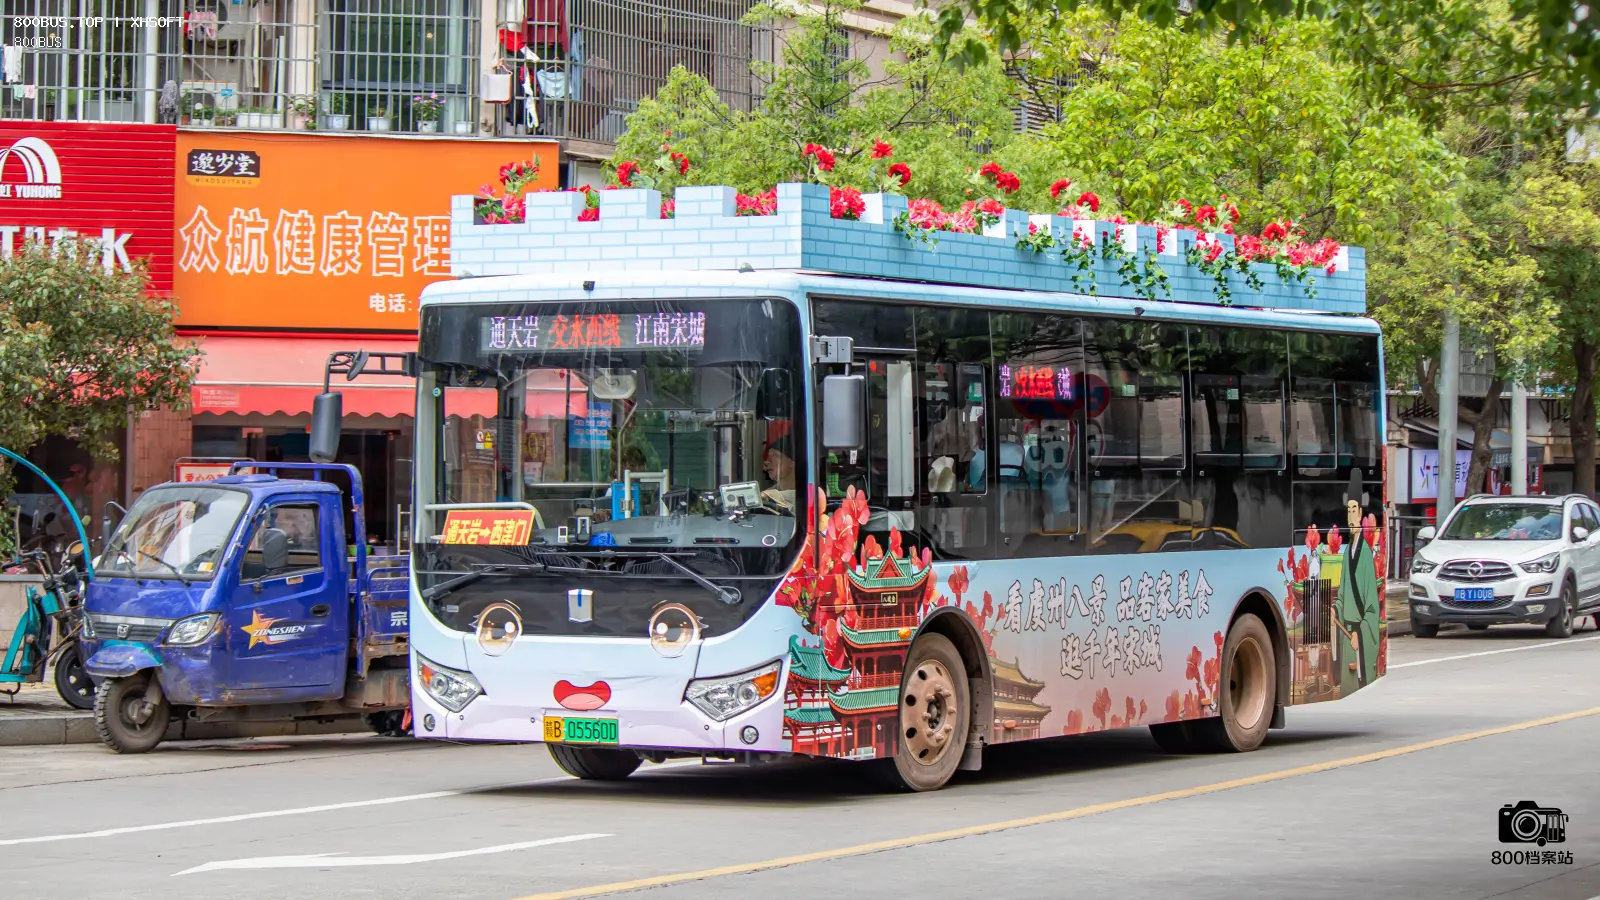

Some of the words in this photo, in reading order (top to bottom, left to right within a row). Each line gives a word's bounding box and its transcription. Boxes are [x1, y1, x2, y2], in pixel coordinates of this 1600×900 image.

[15, 185, 62, 198] YUHONG
[178, 204, 452, 278] 众航健康管理
[489, 315, 540, 349] 通天岩
[635, 311, 706, 347] 江南宋城
[445, 519, 483, 545] 通天岩
[489, 518, 527, 545] 西津门
[1116, 568, 1214, 622] 品客家美食
[253, 624, 307, 637] ZONGSHEN
[390, 611, 408, 626] 宗
